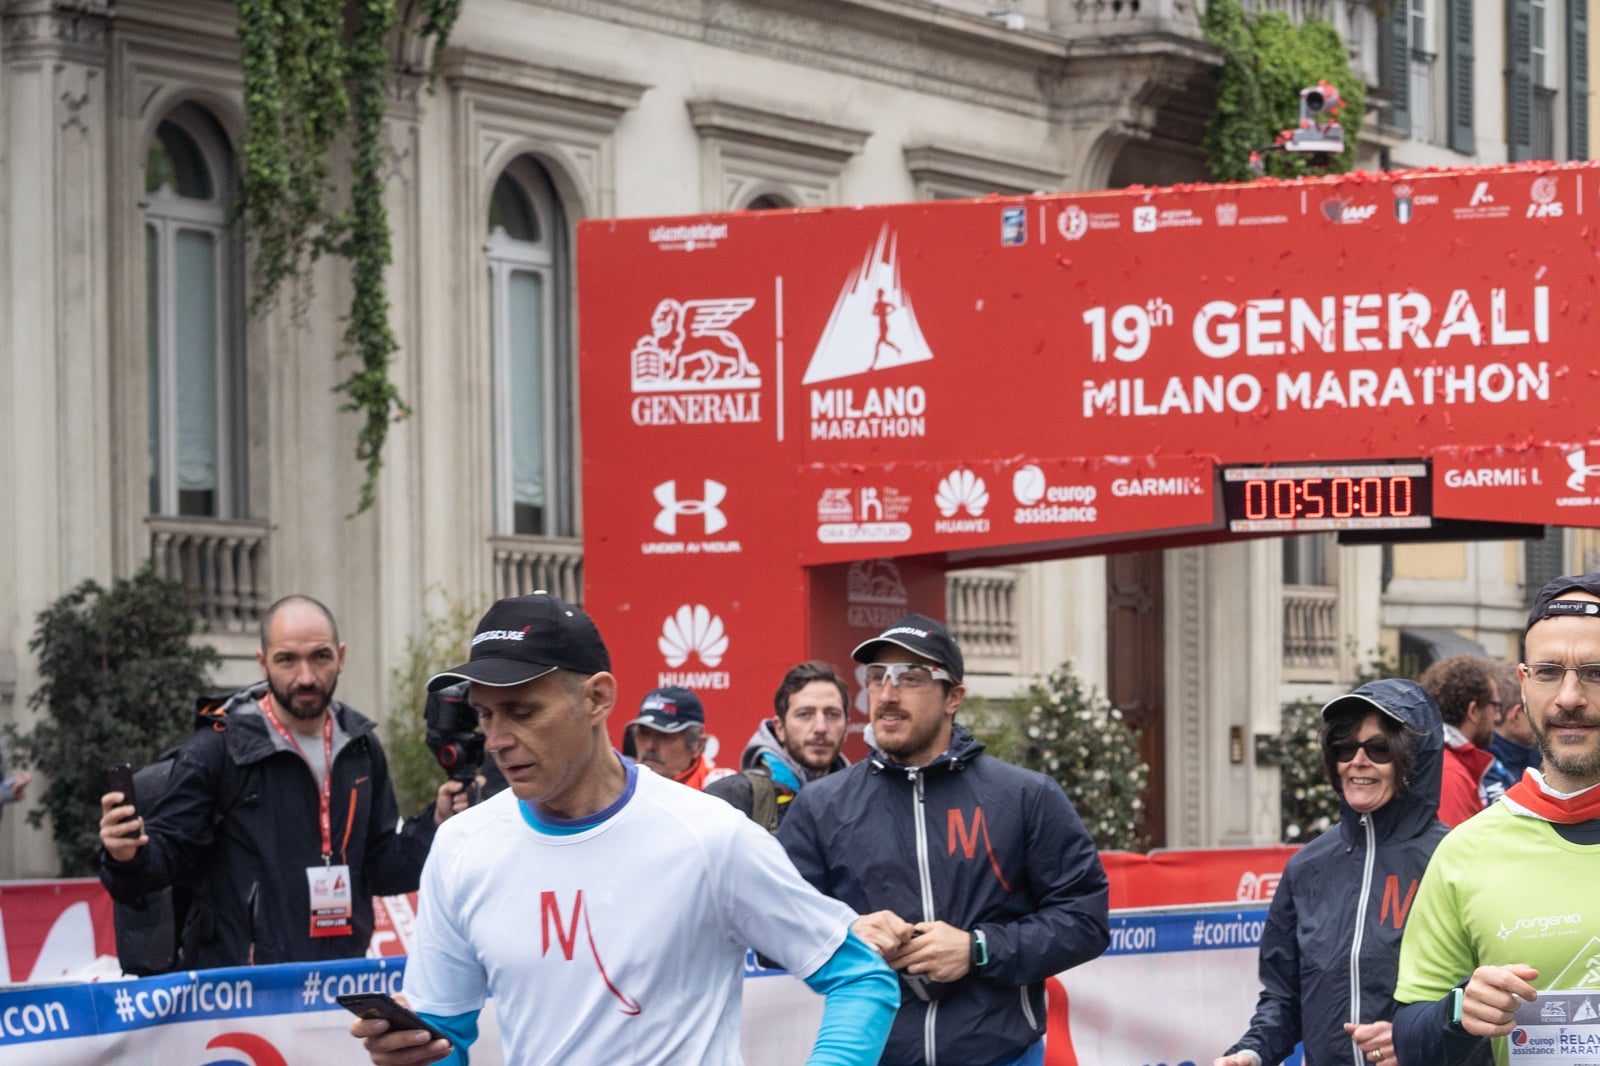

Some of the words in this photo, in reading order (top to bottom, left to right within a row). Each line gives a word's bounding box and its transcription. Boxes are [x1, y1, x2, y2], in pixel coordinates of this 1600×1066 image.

[1082, 298, 1173, 363] 19th
[1192, 286, 1550, 359] GENERALI
[811, 386, 926, 420] MILANO
[1083, 373, 1262, 418] MILANO
[1277, 361, 1550, 411] MARATHON
[632, 393, 761, 426] GENERALI
[811, 416, 926, 440] MARATHON
[1014, 501, 1097, 524] assistance
[1047, 485, 1097, 508] europ
[1245, 476, 1412, 520] 00:50:00
[935, 518, 990, 533] HUAWEI
[658, 672, 730, 690] HUAWEI
[1109, 919, 1156, 952] ricon
[1192, 913, 1265, 946] #corrico
[1511, 913, 1582, 932] sorgenia
[114, 971, 254, 1022] #corricon
[303, 958, 402, 1006] #corric
[1512, 1047, 1555, 1055] assistance
[1529, 1037, 1555, 1046] europ
